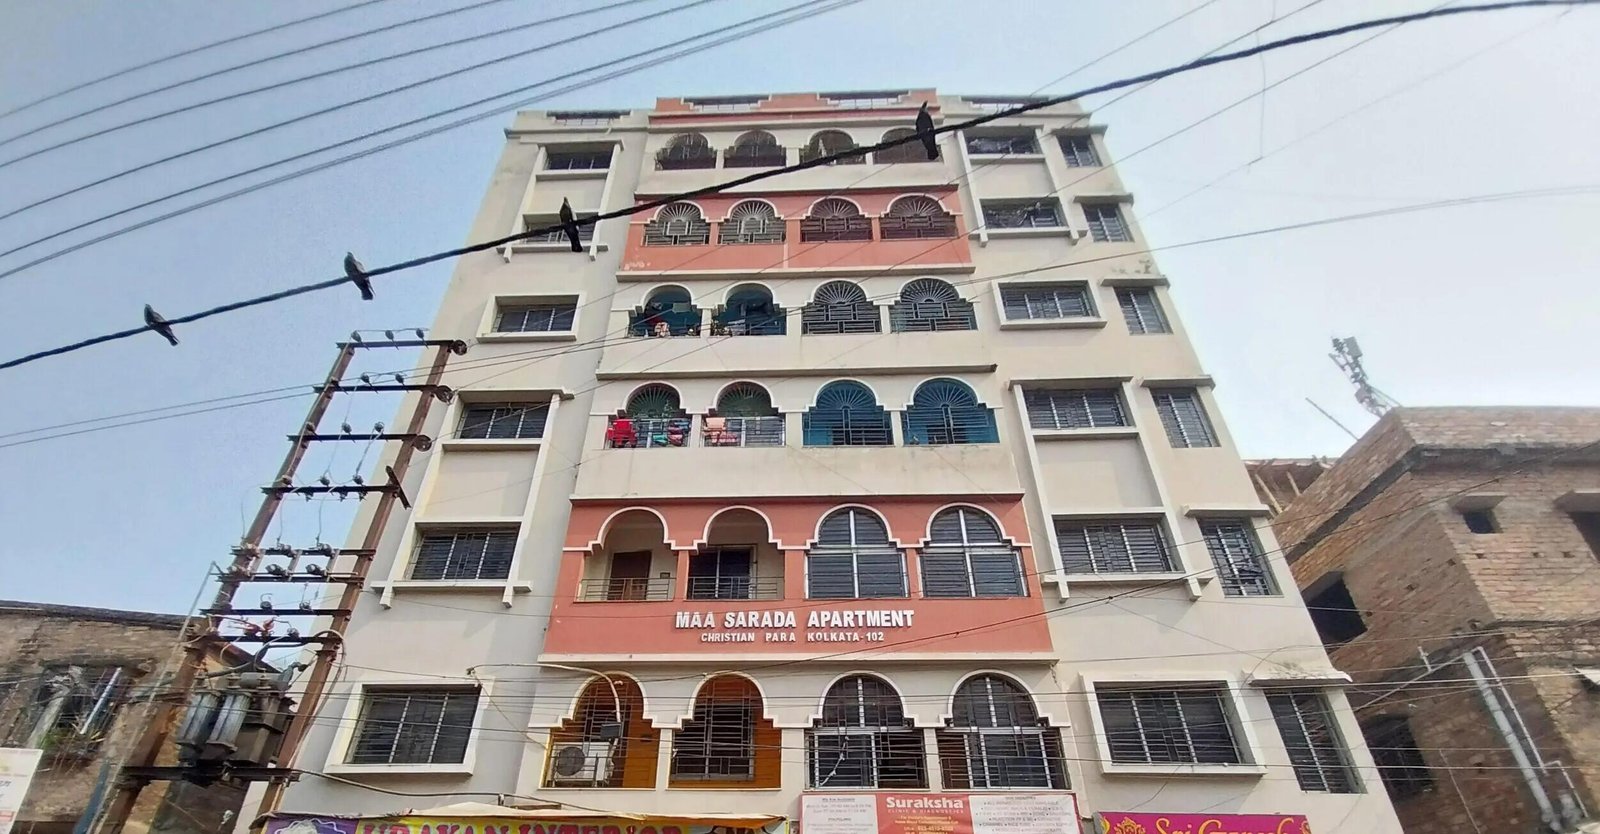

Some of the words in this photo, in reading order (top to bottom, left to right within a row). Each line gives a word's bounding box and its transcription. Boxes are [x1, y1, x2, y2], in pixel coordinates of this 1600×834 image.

[675, 611, 716, 628] MAA
[724, 610, 797, 628] SARADA
[807, 609, 915, 627] APARTMENT
[701, 632, 755, 642] CHRISTIAN
[765, 632, 796, 642] PARA
[807, 631, 885, 642] KOLKATA-102
[886, 796, 964, 809] Suraksha
